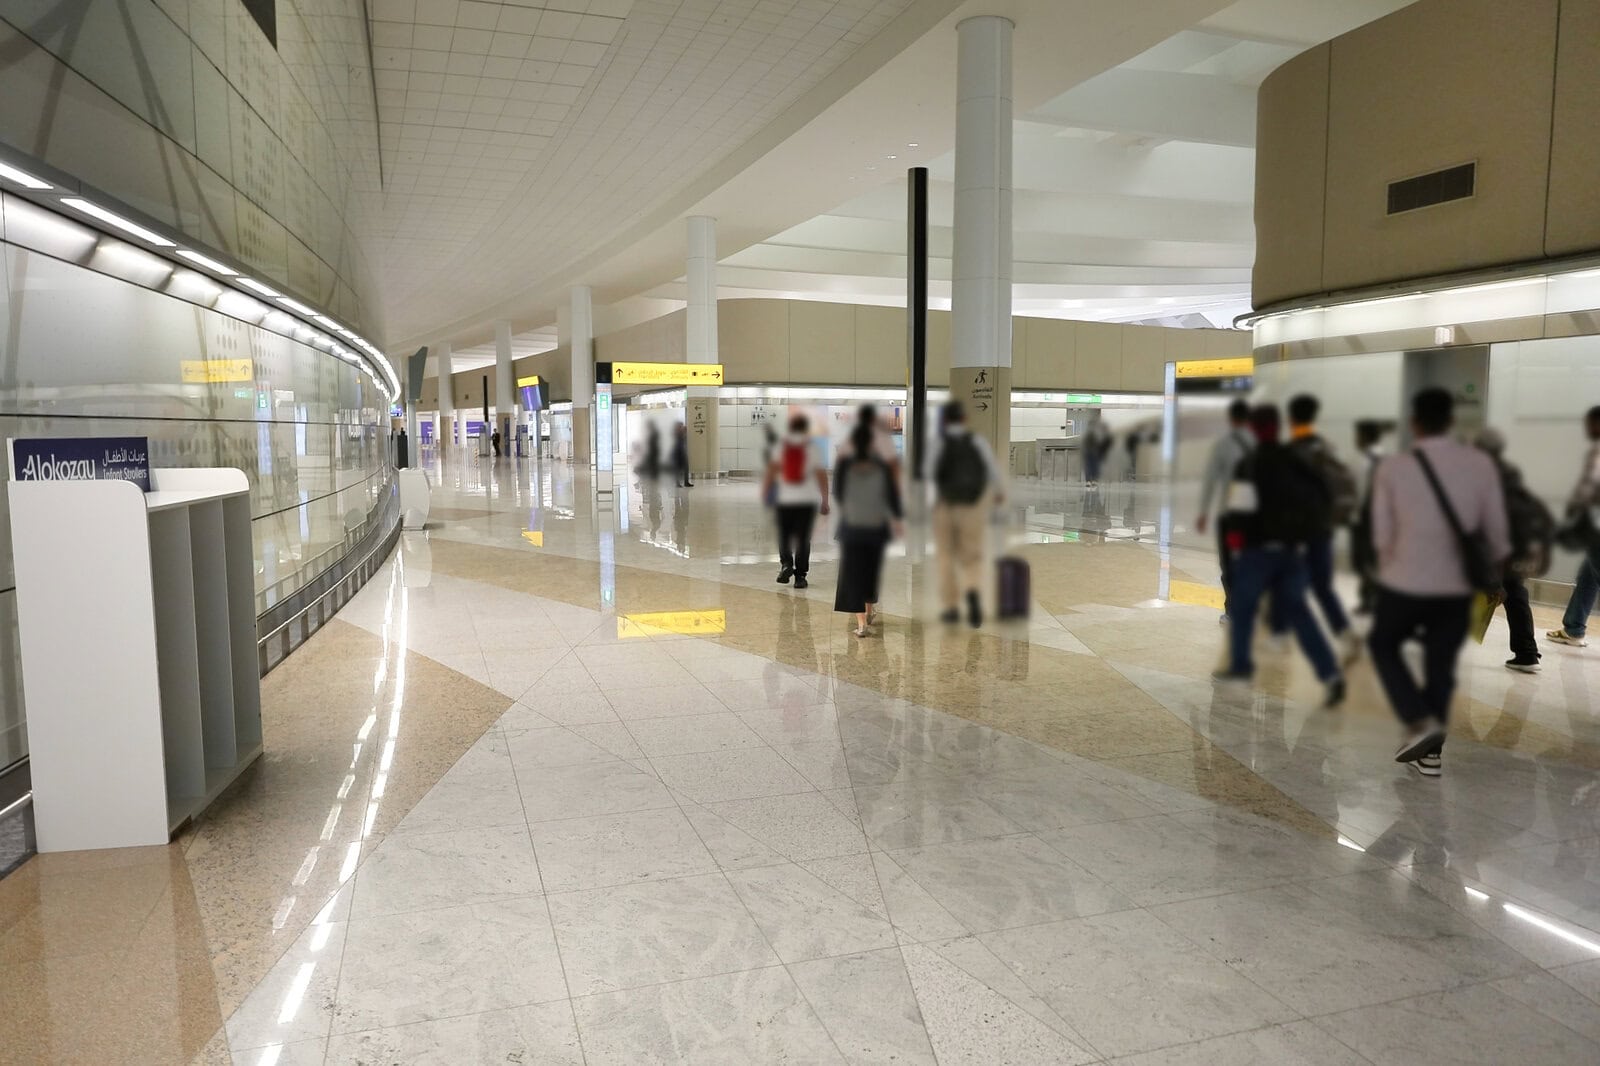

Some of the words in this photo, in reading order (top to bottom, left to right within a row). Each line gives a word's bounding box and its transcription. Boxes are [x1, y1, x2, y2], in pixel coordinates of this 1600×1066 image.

[102, 447, 127, 466] الأطفال
[128, 449, 146, 464] عربات
[22, 453, 96, 480] Alokozay
[103, 468, 122, 480] Infant
[123, 466, 147, 480] Strollers
